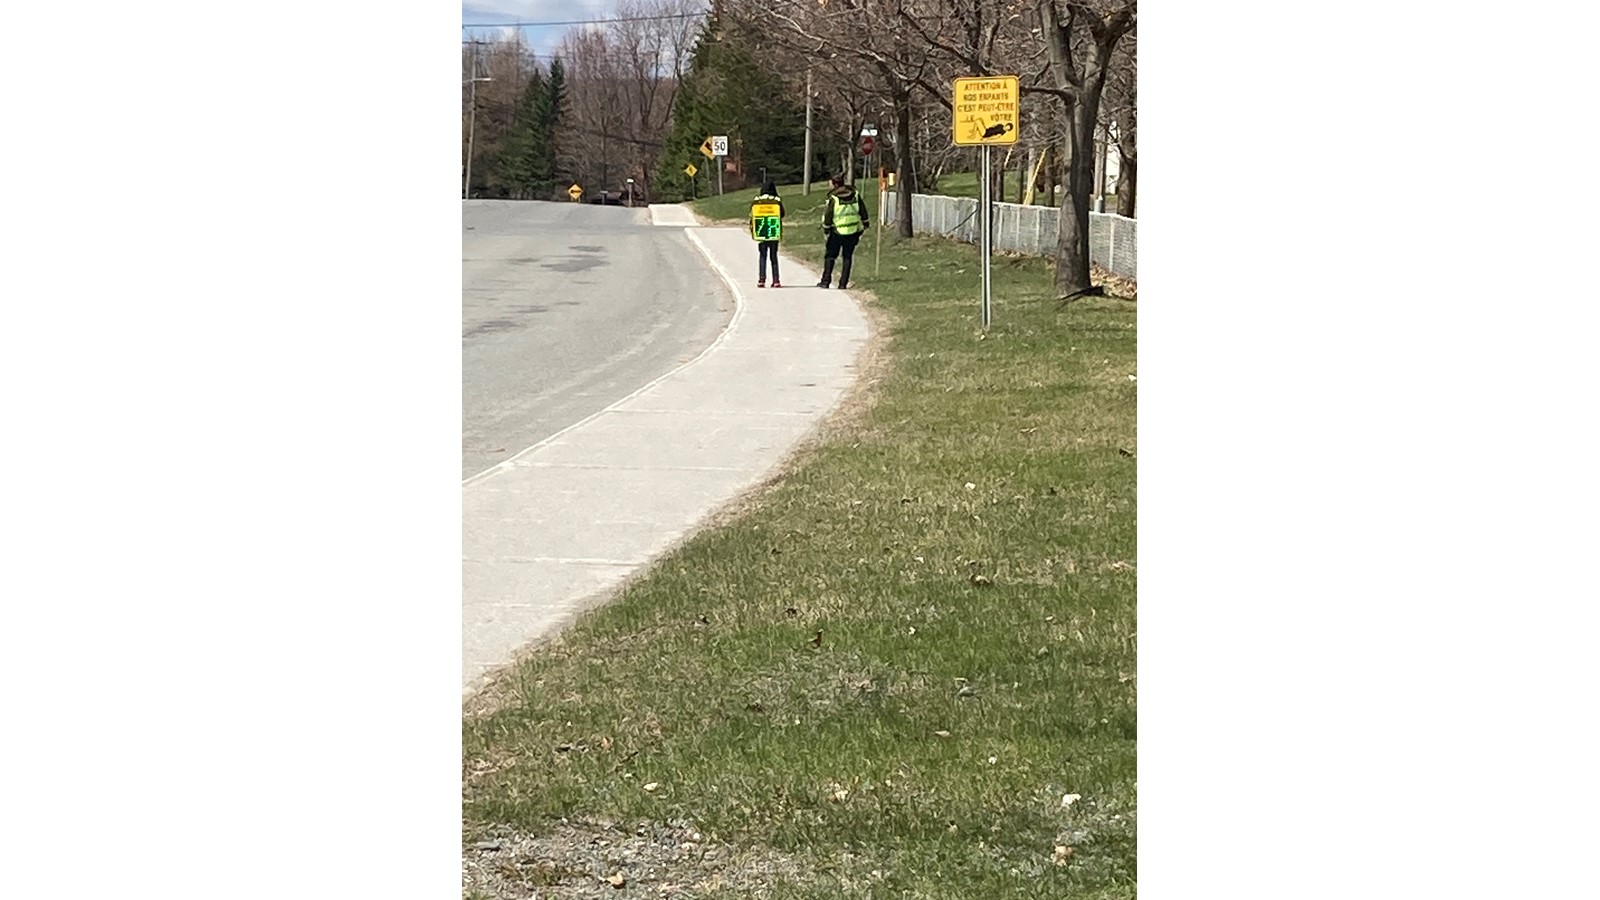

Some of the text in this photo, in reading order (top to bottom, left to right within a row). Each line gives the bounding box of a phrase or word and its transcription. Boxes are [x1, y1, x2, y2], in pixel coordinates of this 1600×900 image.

[964, 82, 1001, 91] ATTENTION
[963, 93, 977, 101] NOS
[714, 141, 726, 151] 50
